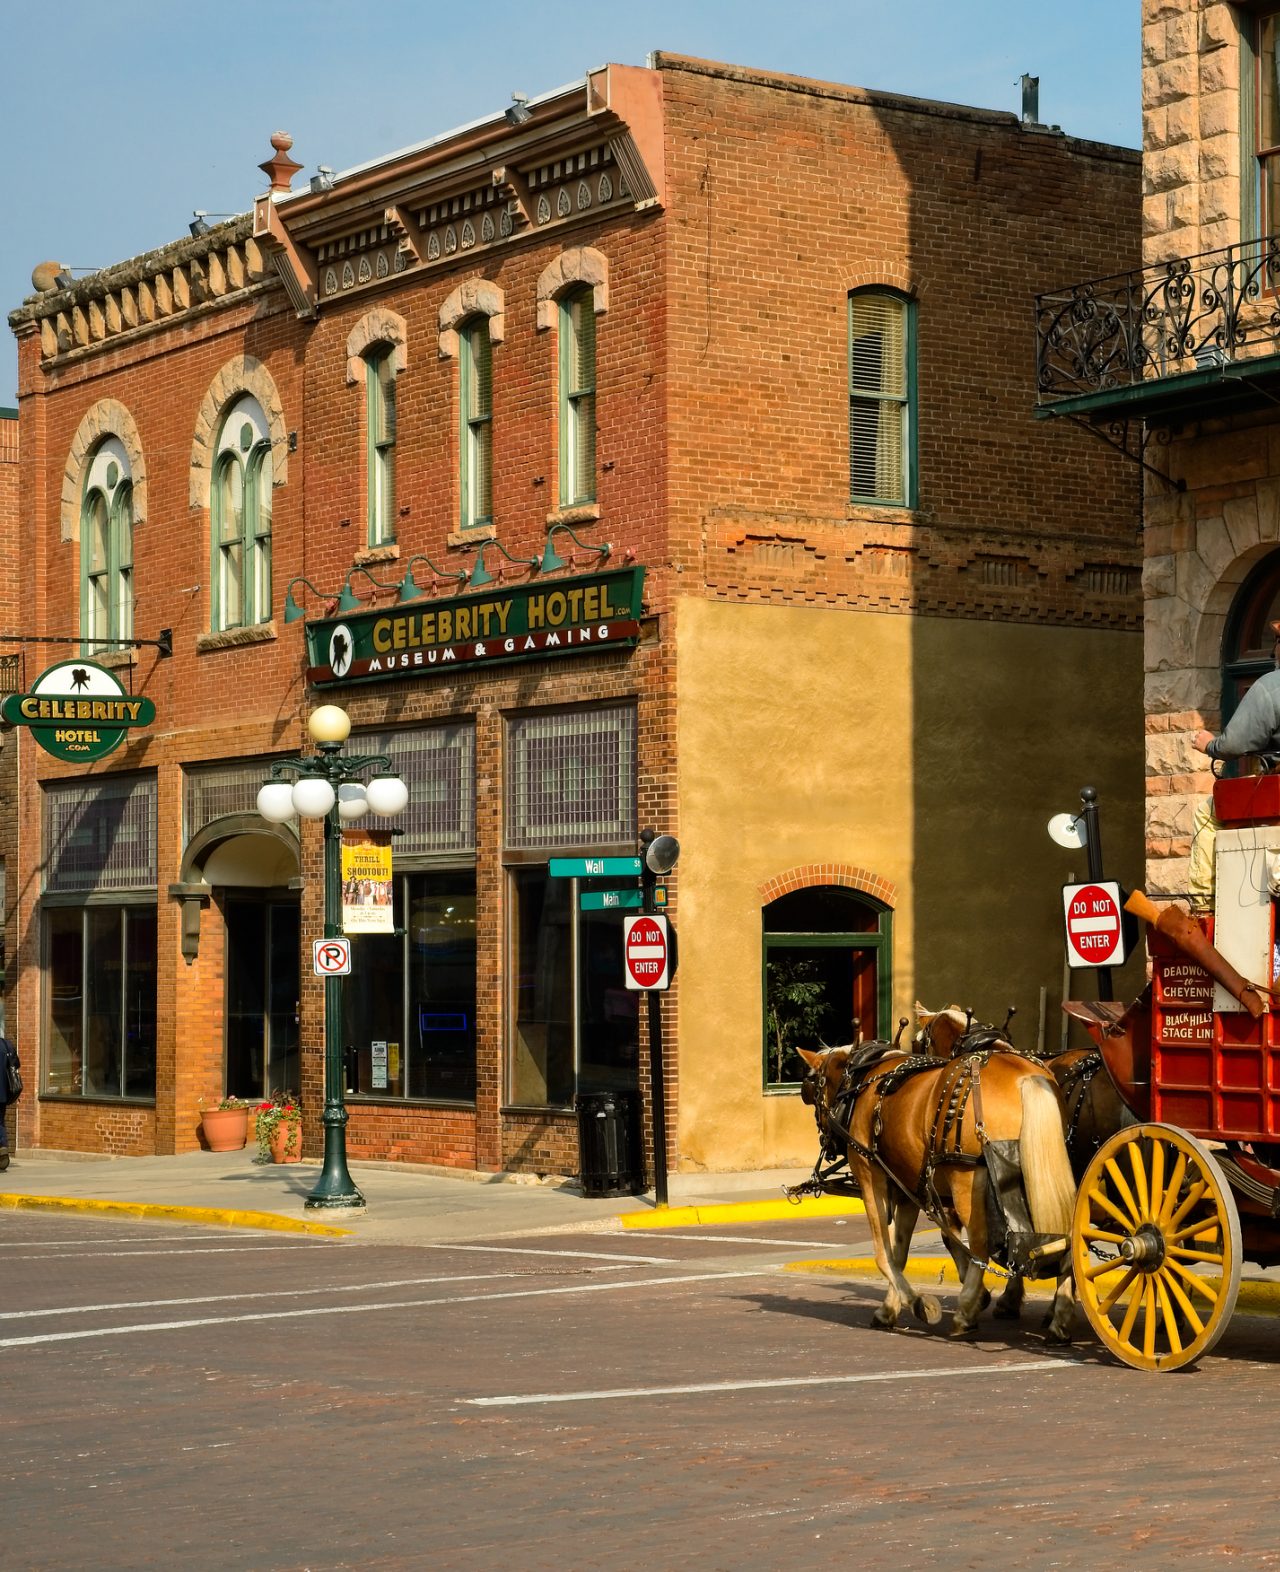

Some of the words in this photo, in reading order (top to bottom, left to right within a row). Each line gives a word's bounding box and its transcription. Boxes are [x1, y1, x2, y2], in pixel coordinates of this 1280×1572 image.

[372, 600, 513, 653] CELEBRITY
[527, 584, 615, 629] HOTEL
[368, 647, 456, 672] MUSEUM
[474, 643, 486, 656] &
[504, 625, 609, 651] GAMING
[20, 697, 142, 721] CELEBRITY
[55, 729, 102, 743] HOTEL
[585, 859, 604, 874] Wall
[634, 860, 641, 868] St
[603, 893, 619, 907] Main
[1073, 901, 1087, 914] DO
[1092, 899, 1111, 913] NOT
[631, 931, 641, 943] DO
[646, 930, 660, 942] NOT
[1080, 934, 1110, 949] ENTER
[635, 962, 659, 974] ENTER
[1163, 965, 1209, 978] DEADWO
[1184, 978, 1194, 986] to
[1163, 986, 1215, 998] CHEYENNE
[1165, 1012, 1189, 1026] BLACK
[1189, 1012, 1213, 1027] HILLS
[1162, 1027, 1193, 1039] STAGE
